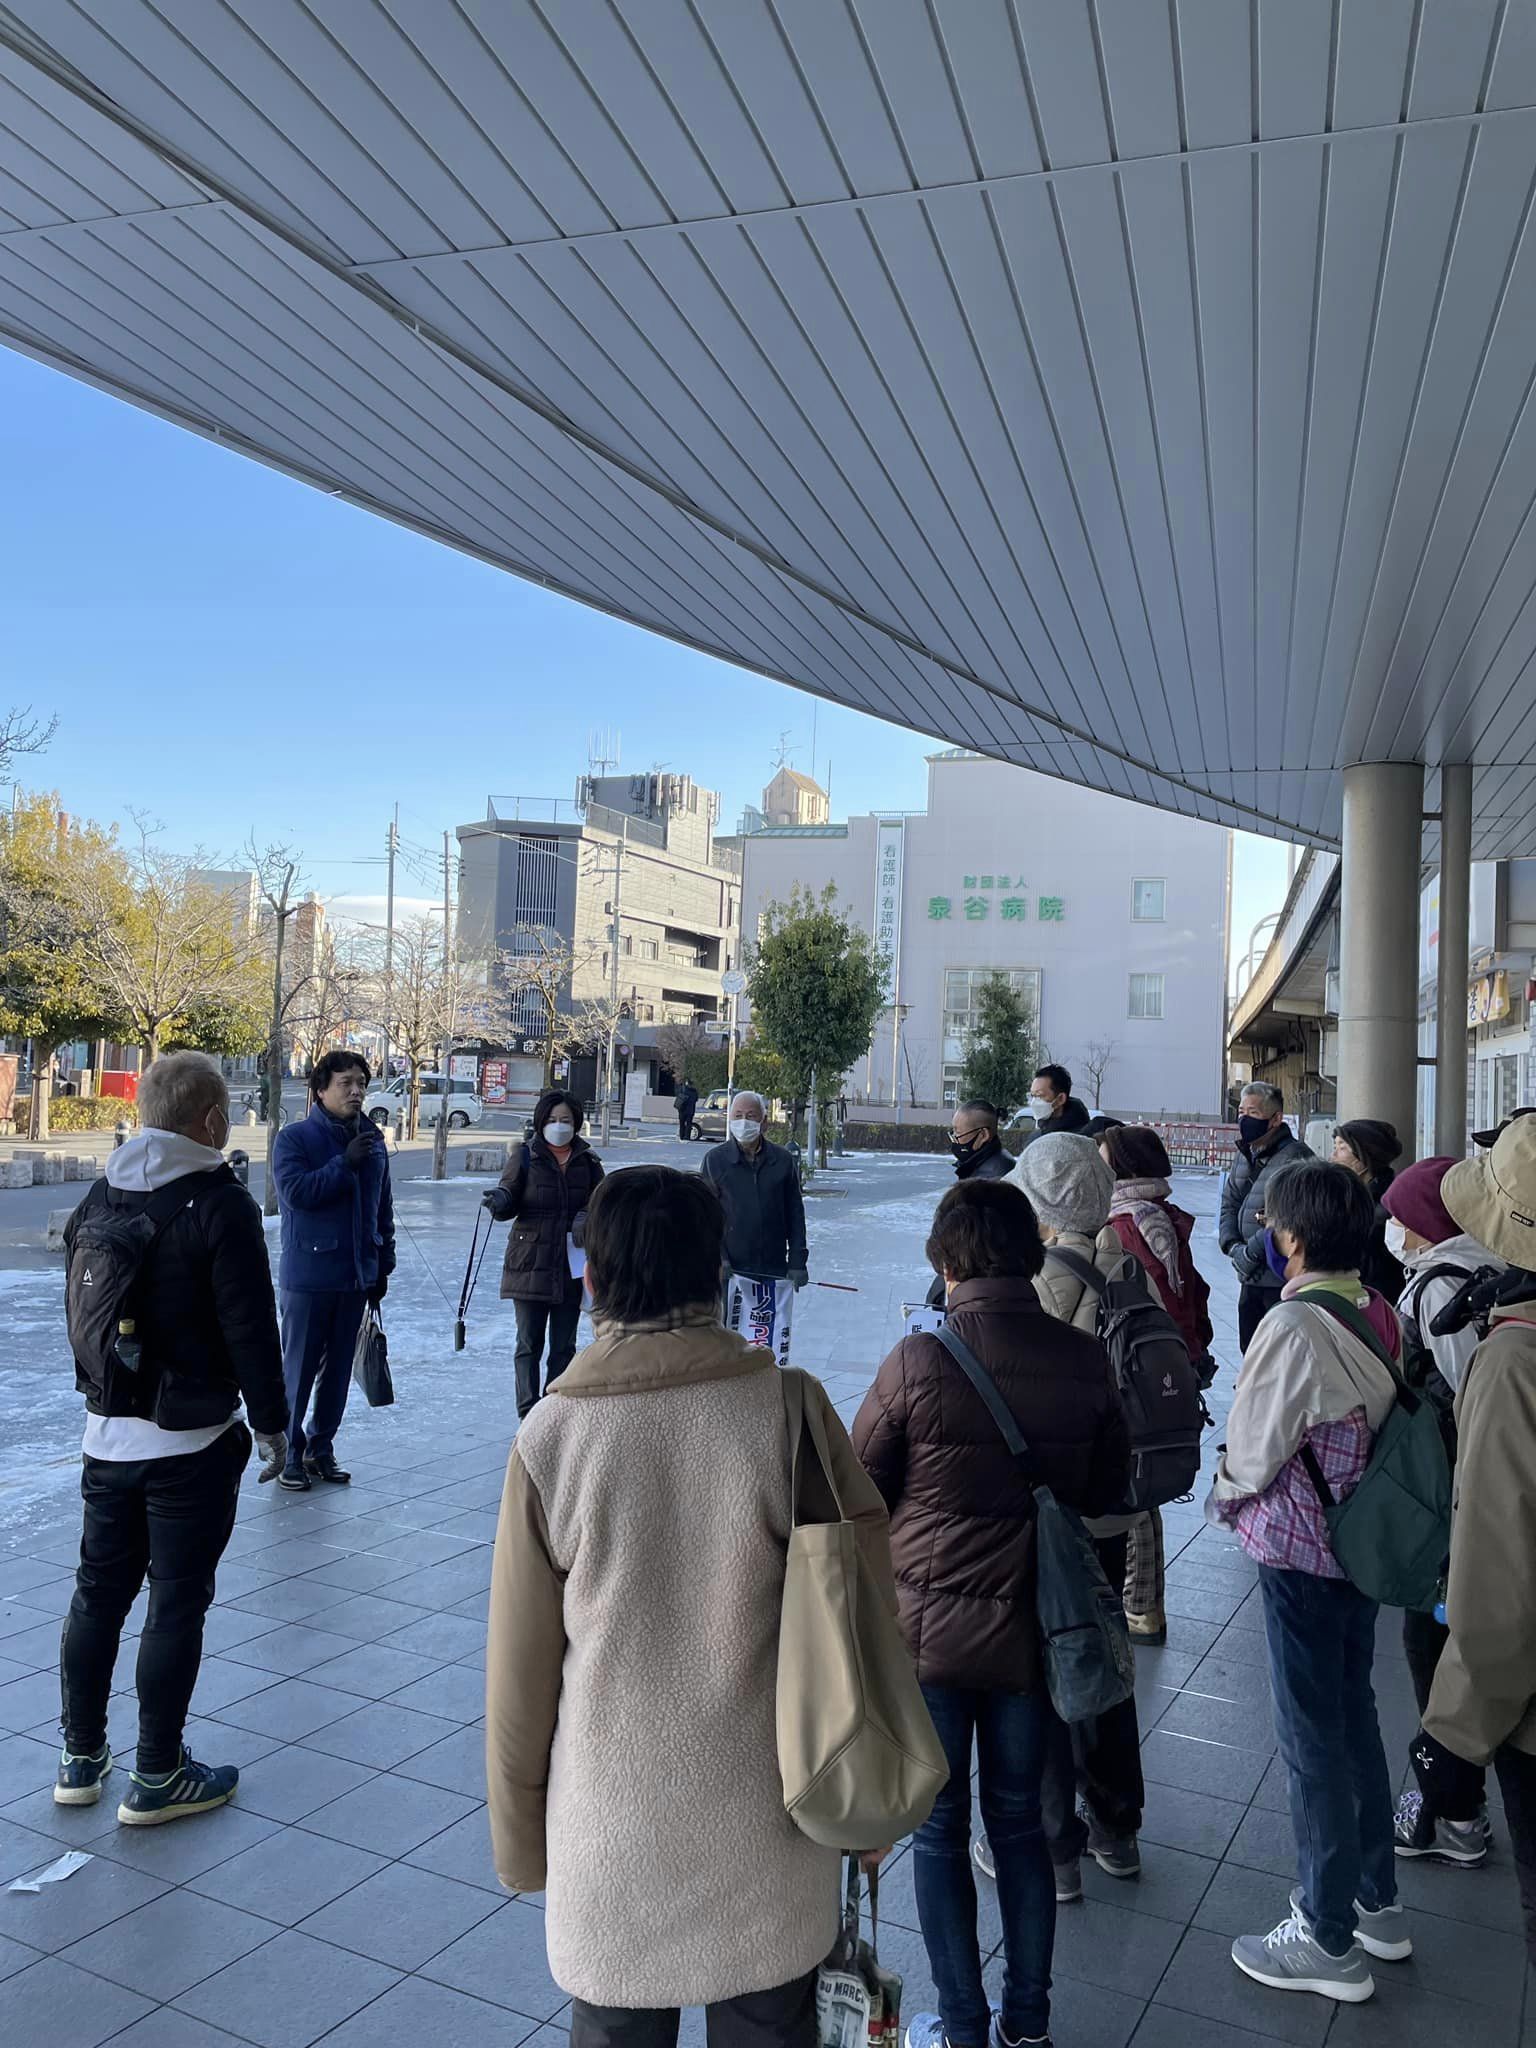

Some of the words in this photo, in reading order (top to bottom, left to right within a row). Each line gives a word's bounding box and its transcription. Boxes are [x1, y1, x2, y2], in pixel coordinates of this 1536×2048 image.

[963, 875, 1028, 888] 財団法人
[927, 896, 1064, 921] 泉谷病院
